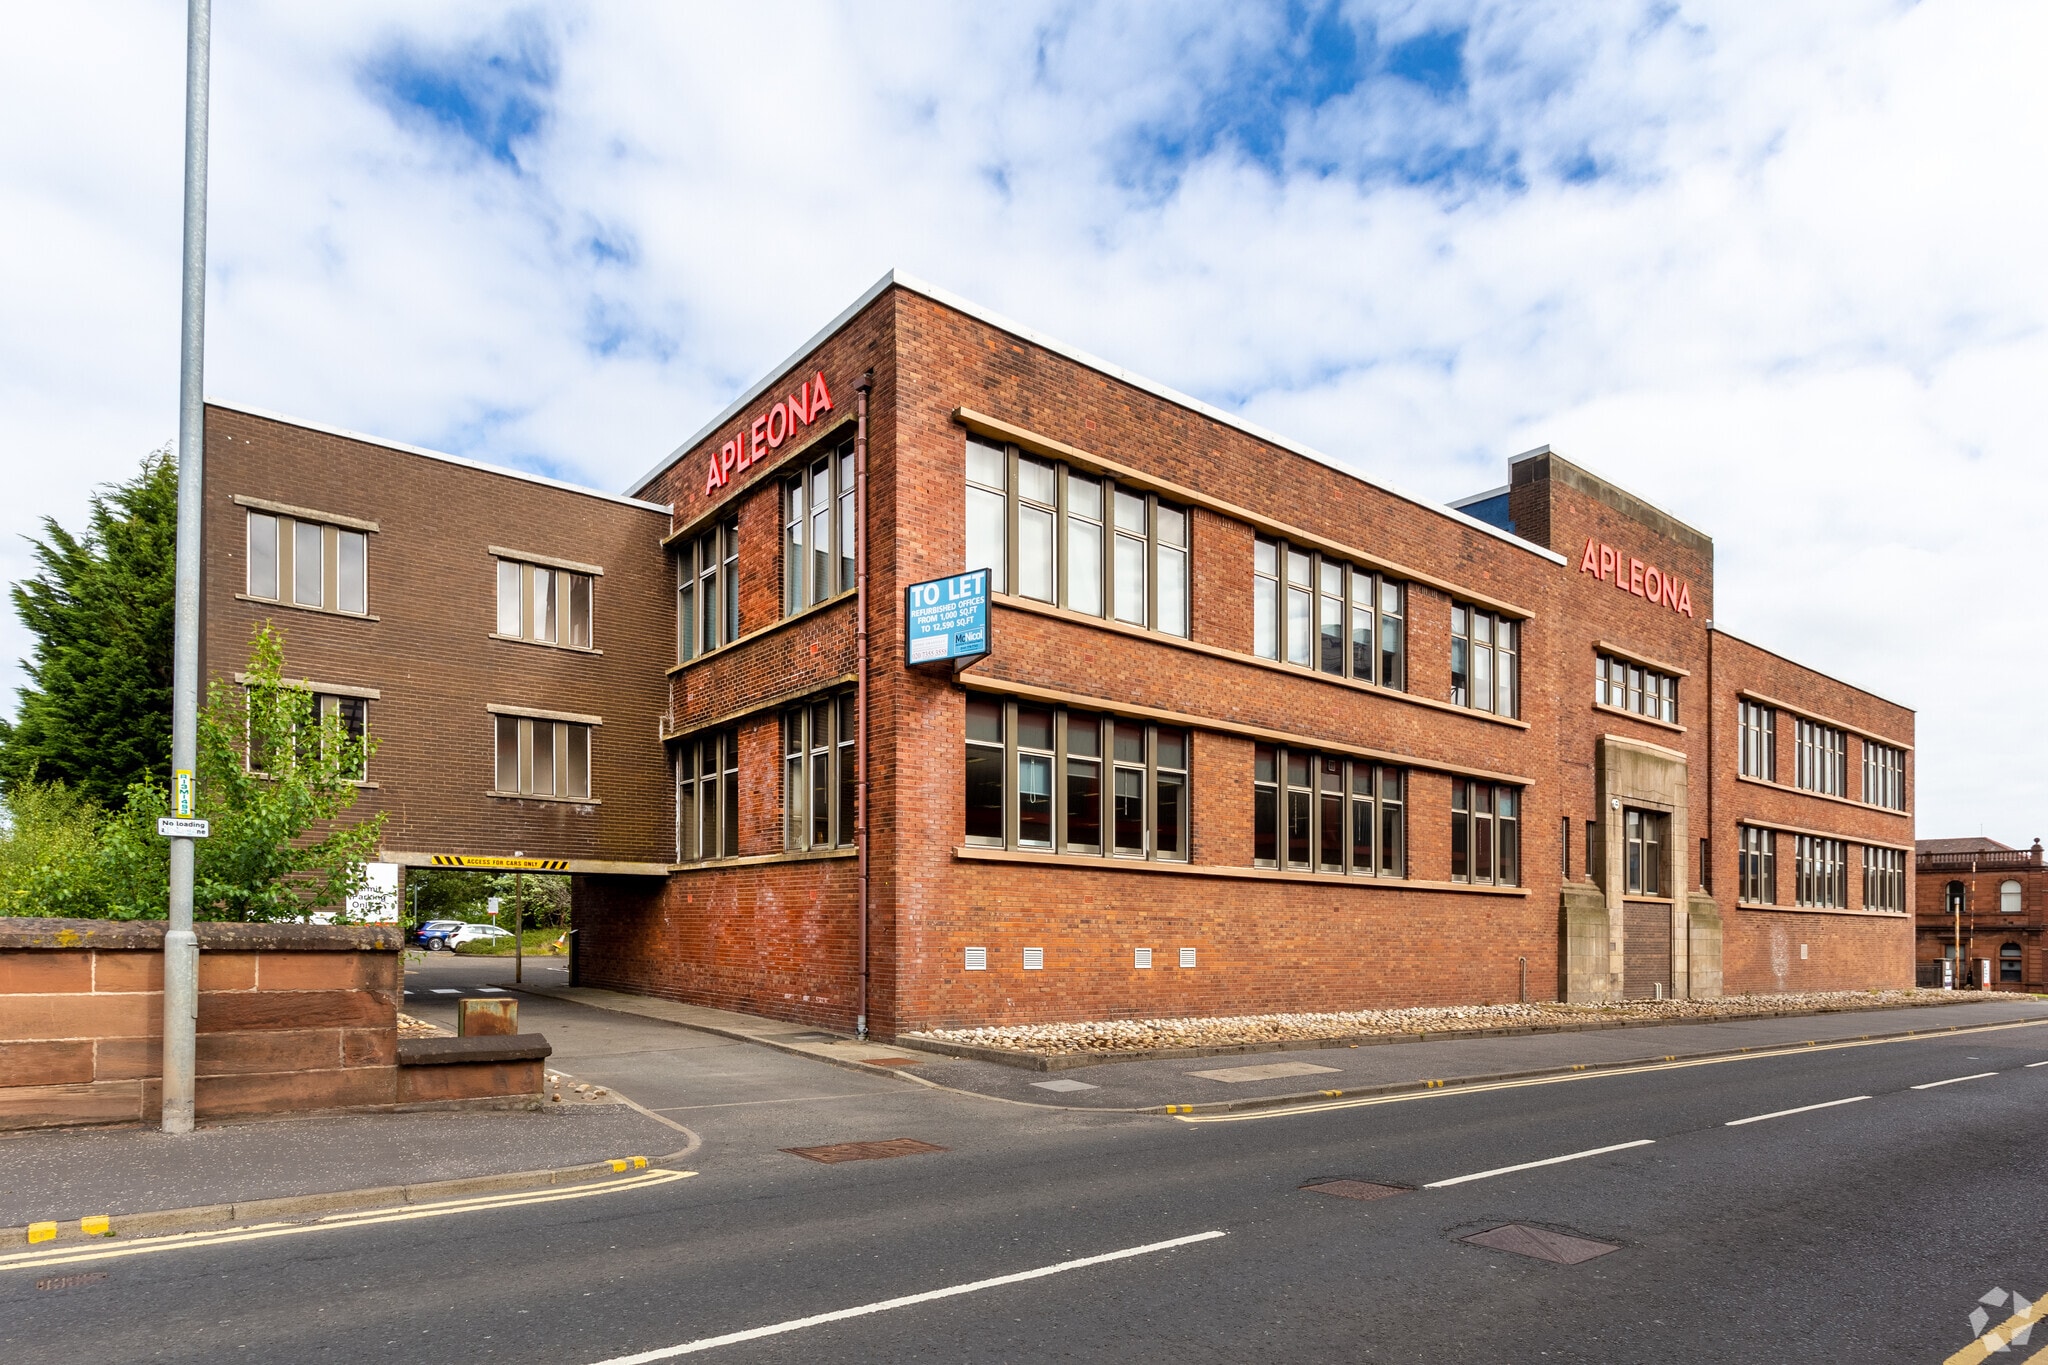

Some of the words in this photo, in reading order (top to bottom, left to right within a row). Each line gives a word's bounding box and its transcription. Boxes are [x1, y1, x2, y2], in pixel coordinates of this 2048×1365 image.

[705, 370, 835, 496] APLEONA
[1580, 537, 1693, 618] APLEONA
[911, 583, 940, 608] TO
[948, 571, 985, 601] LET
[911, 602, 957, 618] REFURBISHED
[957, 595, 985, 609] OFFICES
[917, 614, 938, 624] FROM
[940, 611, 958, 621] 1,000
[959, 605, 978, 617] SQ.FT
[921, 625, 931, 633] TO
[956, 615, 975, 627] SQ.FT
[955, 629, 983, 644] McNicol
[176, 820, 206, 829] loading
